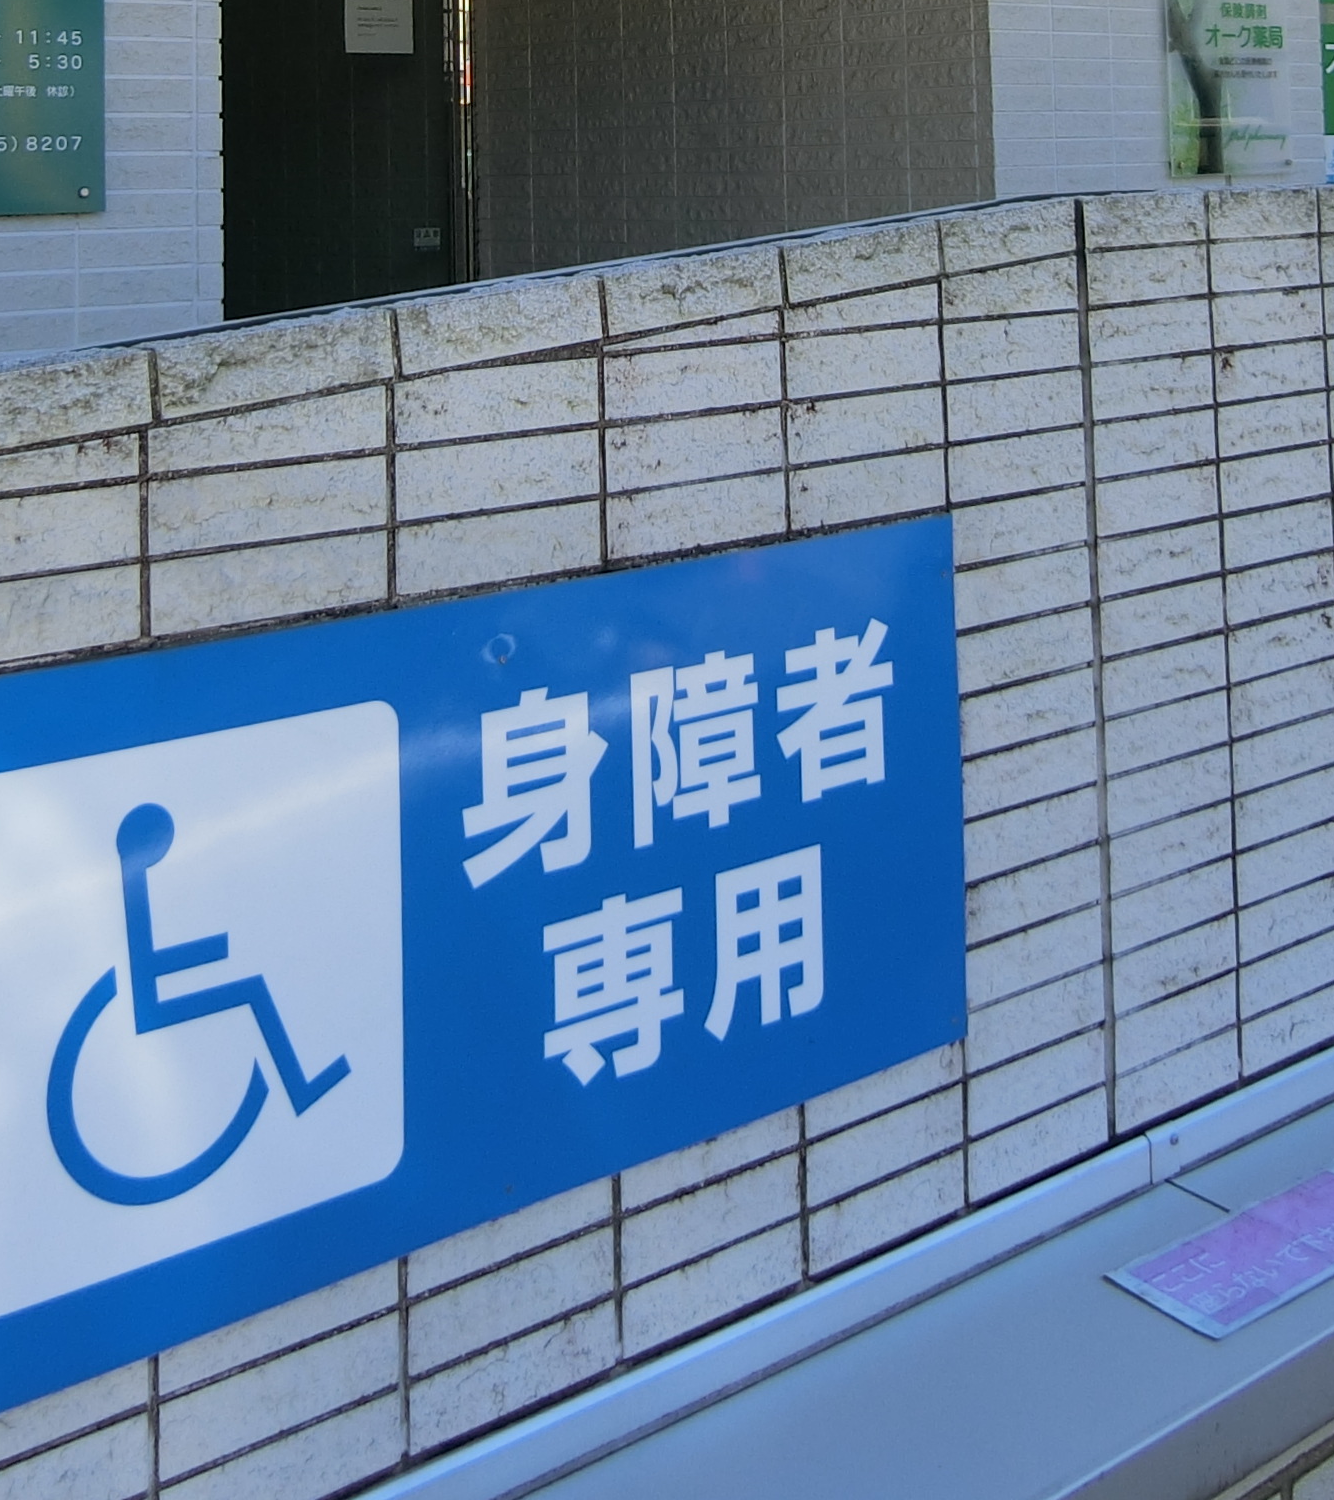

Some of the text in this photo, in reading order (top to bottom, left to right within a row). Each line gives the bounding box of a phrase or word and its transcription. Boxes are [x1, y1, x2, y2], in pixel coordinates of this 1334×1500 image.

[1220, 2, 1267, 19] 保険調剤
[1205, 25, 1284, 49] オーク薬局
[462, 618, 894, 889] 身障者
[543, 844, 824, 1086] 専用
[1152, 1252, 1225, 1293] ここに
